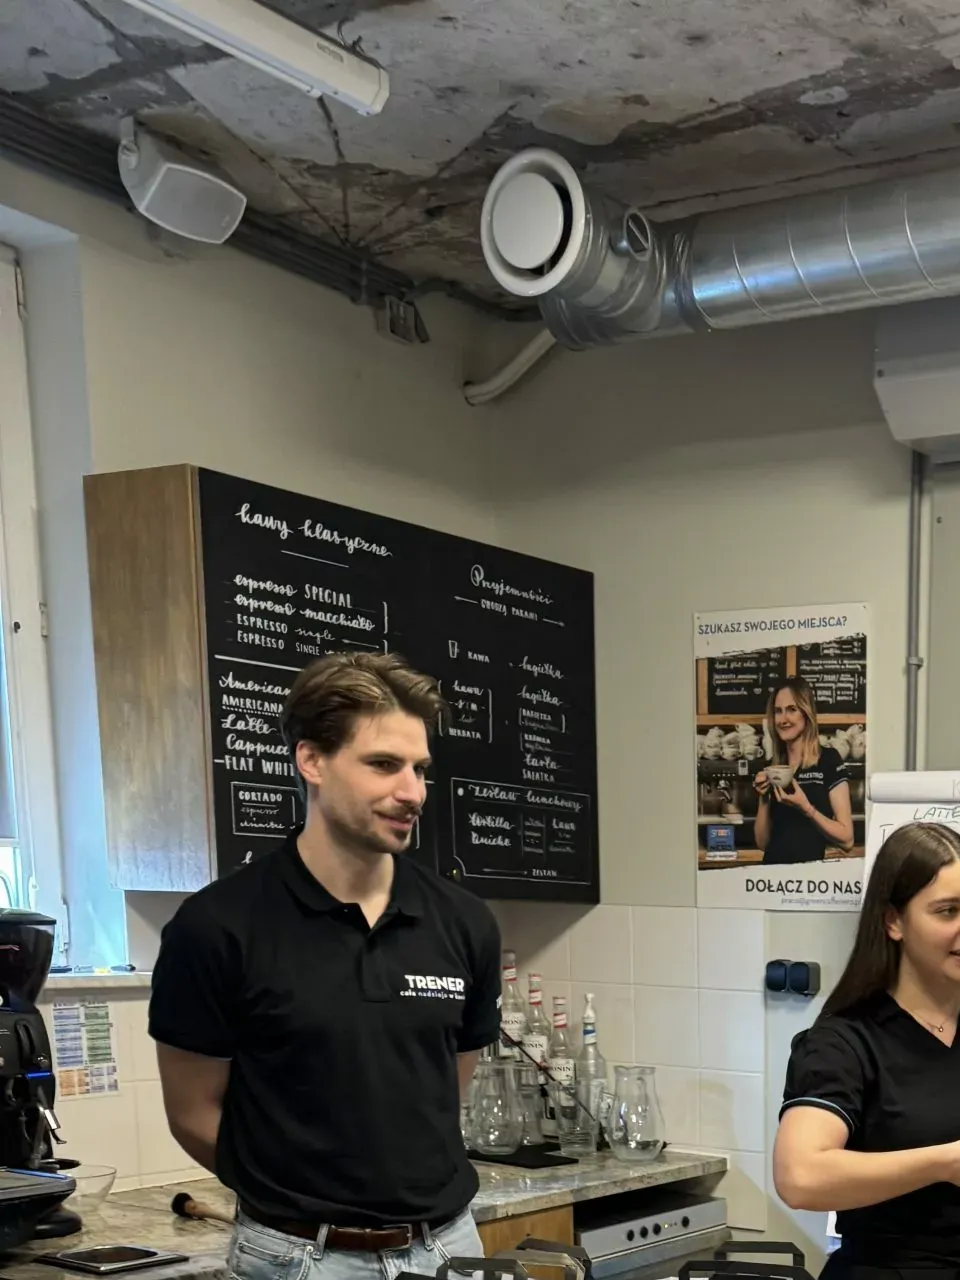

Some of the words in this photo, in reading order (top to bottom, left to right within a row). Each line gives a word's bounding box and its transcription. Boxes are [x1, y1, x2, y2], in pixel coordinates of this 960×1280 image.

[298, 519, 393, 557] klasyczne
[233, 574, 297, 597] espresso
[304, 583, 352, 608] SPECIAL
[234, 594, 296, 616] espresso
[237, 614, 288, 634] ESPRESSO
[698, 622, 742, 635] SZUKASZ
[744, 619, 796, 633] SWOJEGO
[798, 615, 848, 629] MIEJSCA?
[237, 630, 285, 650] ESPRESSO
[296, 642, 320, 656] SINGLE
[218, 671, 291, 696] American
[221, 714, 277, 734] Latte
[224, 755, 254, 772] FLAT
[262, 759, 295, 777] WHIT
[239, 791, 282, 802] CORTADO
[745, 878, 803, 896] DOŁĄCZ
[807, 880, 829, 894] DO
[833, 880, 862, 895] NAS
[404, 974, 465, 992] TRENER
